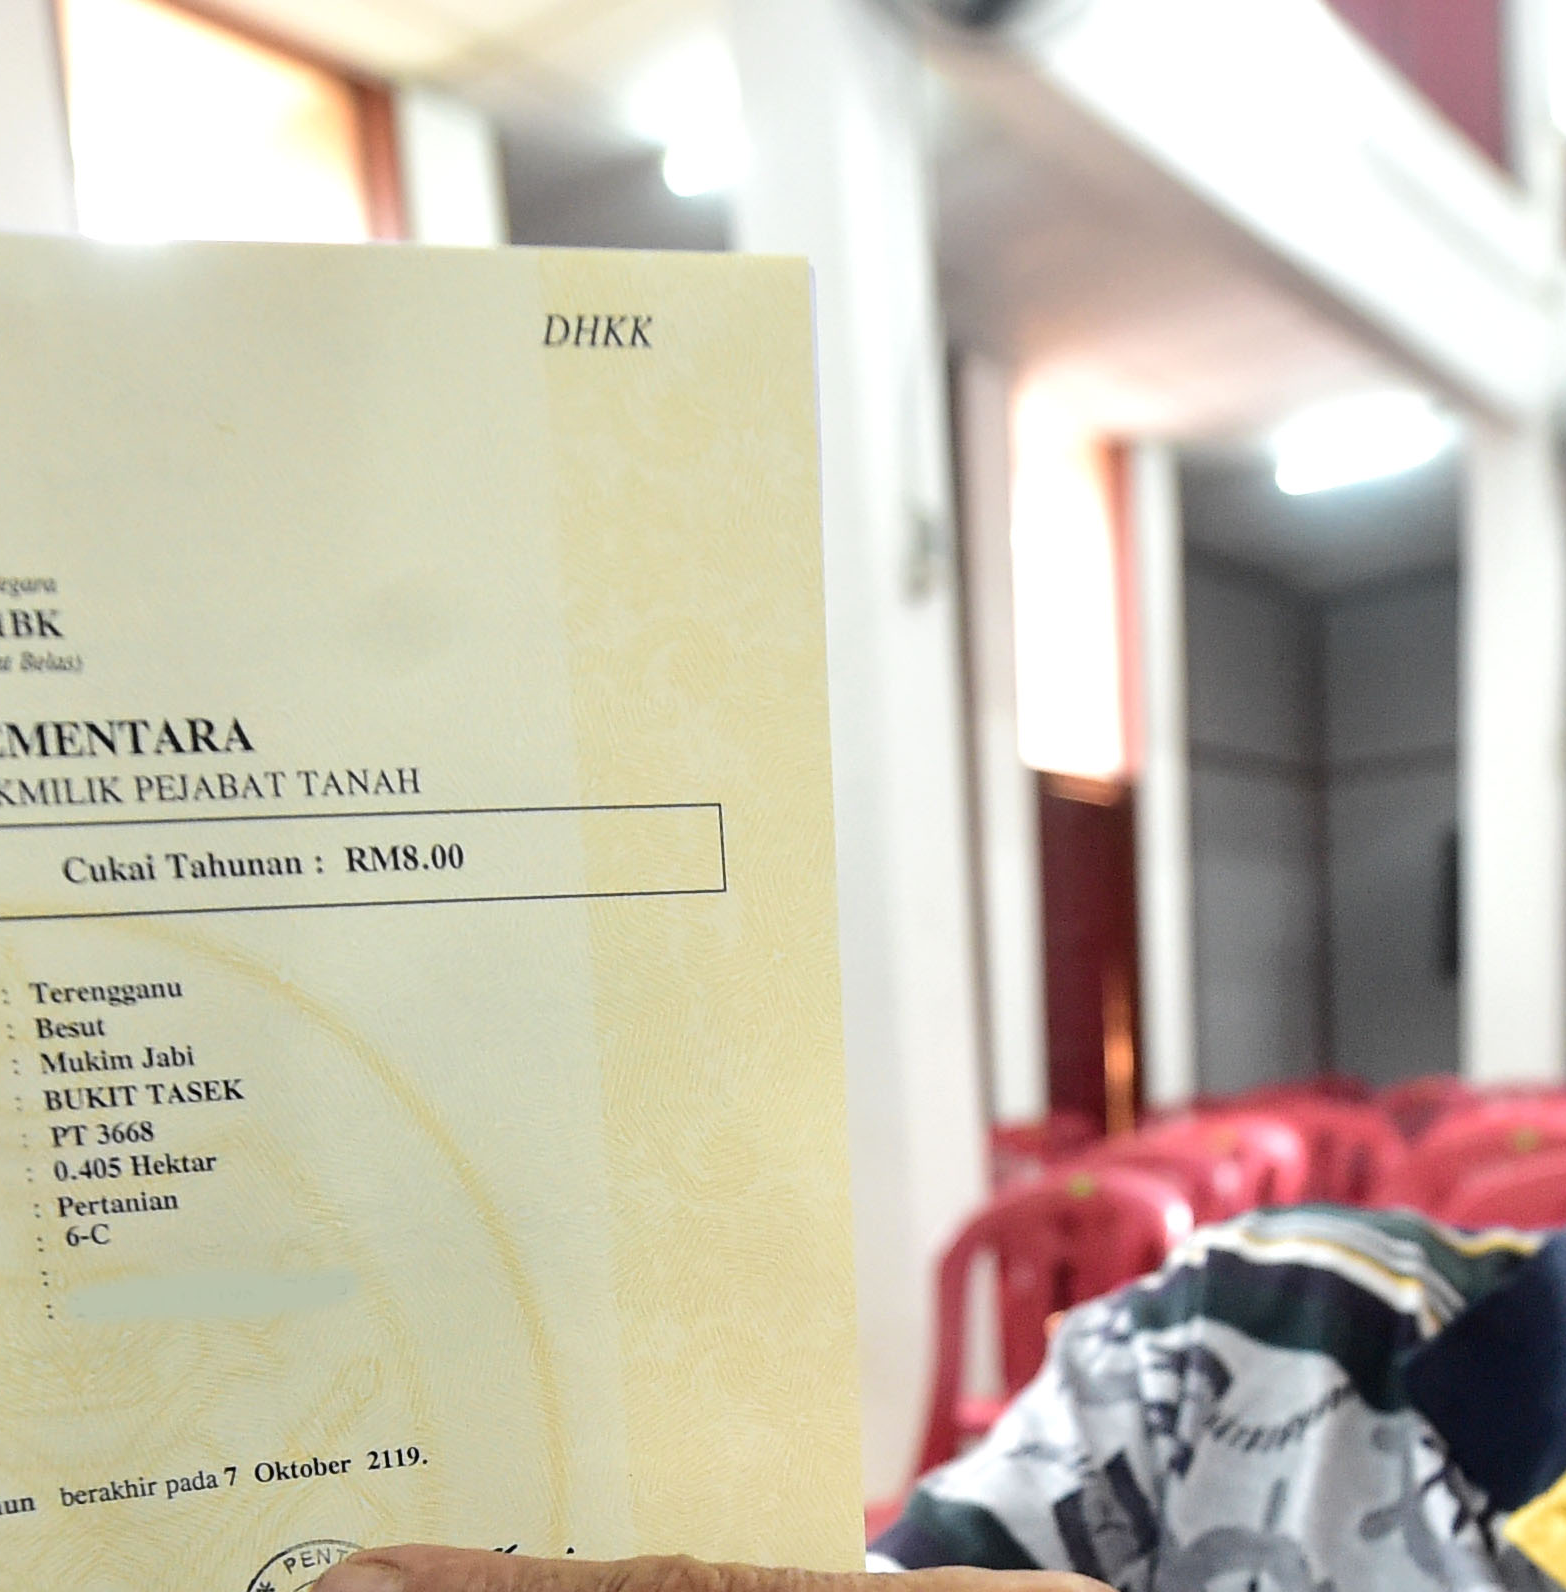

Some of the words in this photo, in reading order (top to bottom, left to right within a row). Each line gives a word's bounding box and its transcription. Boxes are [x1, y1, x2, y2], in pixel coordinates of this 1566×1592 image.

[543, 313, 654, 349] DHKK
[19, 652, 84, 674] Belas)
[136, 769, 288, 804] PEJABAT
[296, 766, 422, 797] TANAH
[62, 851, 155, 886] Cukai
[165, 849, 304, 881] Tahunan
[344, 842, 466, 875] RM8.00
[28, 979, 184, 1007] Terengganu
[34, 1015, 106, 1041] Besut
[39, 1050, 134, 1076] Mukim
[141, 1044, 195, 1071] Jabi
[43, 1083, 139, 1113] BUKIT
[145, 1077, 246, 1106] TASEK
[50, 1124, 88, 1149] PT
[96, 1120, 155, 1146] 3668
[53, 1157, 122, 1184] 0.405
[130, 1150, 218, 1178] Hektar
[56, 1191, 179, 1219] Pertanian
[66, 1223, 112, 1249] 6-C
[58, 1473, 159, 1509] berakhir
[165, 1469, 220, 1500] pada
[223, 1465, 237, 1487] 7
[253, 1453, 353, 1486] Oktober
[365, 1444, 429, 1472] 2119.
